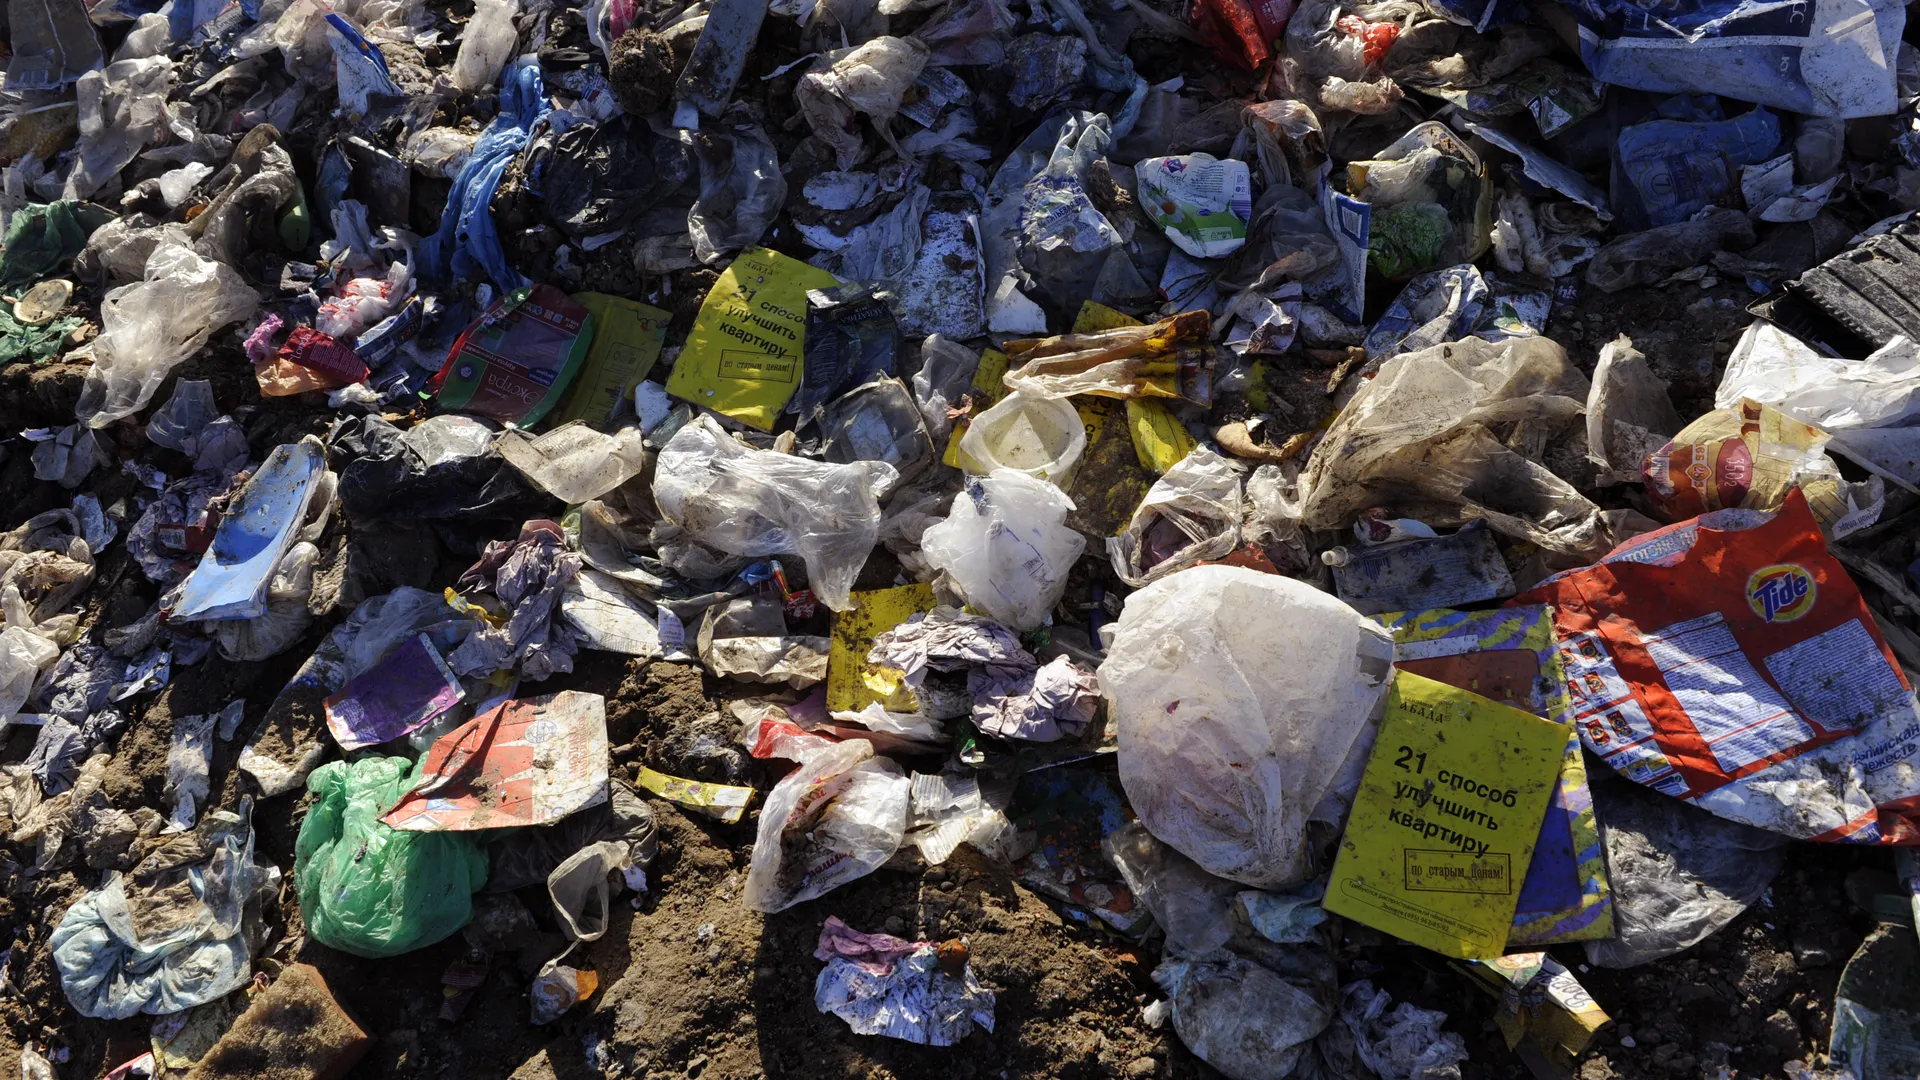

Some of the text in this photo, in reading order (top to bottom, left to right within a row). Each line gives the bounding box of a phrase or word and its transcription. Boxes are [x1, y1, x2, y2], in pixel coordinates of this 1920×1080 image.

[732, 284, 758, 303] 21
[725, 305, 797, 340] улучшить
[293, 333, 312, 359] Londa
[719, 322, 788, 359] квартиру
[724, 360, 790, 373] по старым ценам!
[488, 374, 540, 406] Экстра
[1753, 571, 1808, 623] Tide
[1400, 702, 1443, 723] АБАДА
[1862, 743, 1916, 770] вежесть
[1394, 746, 1518, 808] 21 способ
[1393, 781, 1500, 831] улучшить
[1388, 808, 1491, 859] квартиру
[1411, 865, 1504, 880] по старым ценам!
[1348, 880, 1378, 897] Требуются
